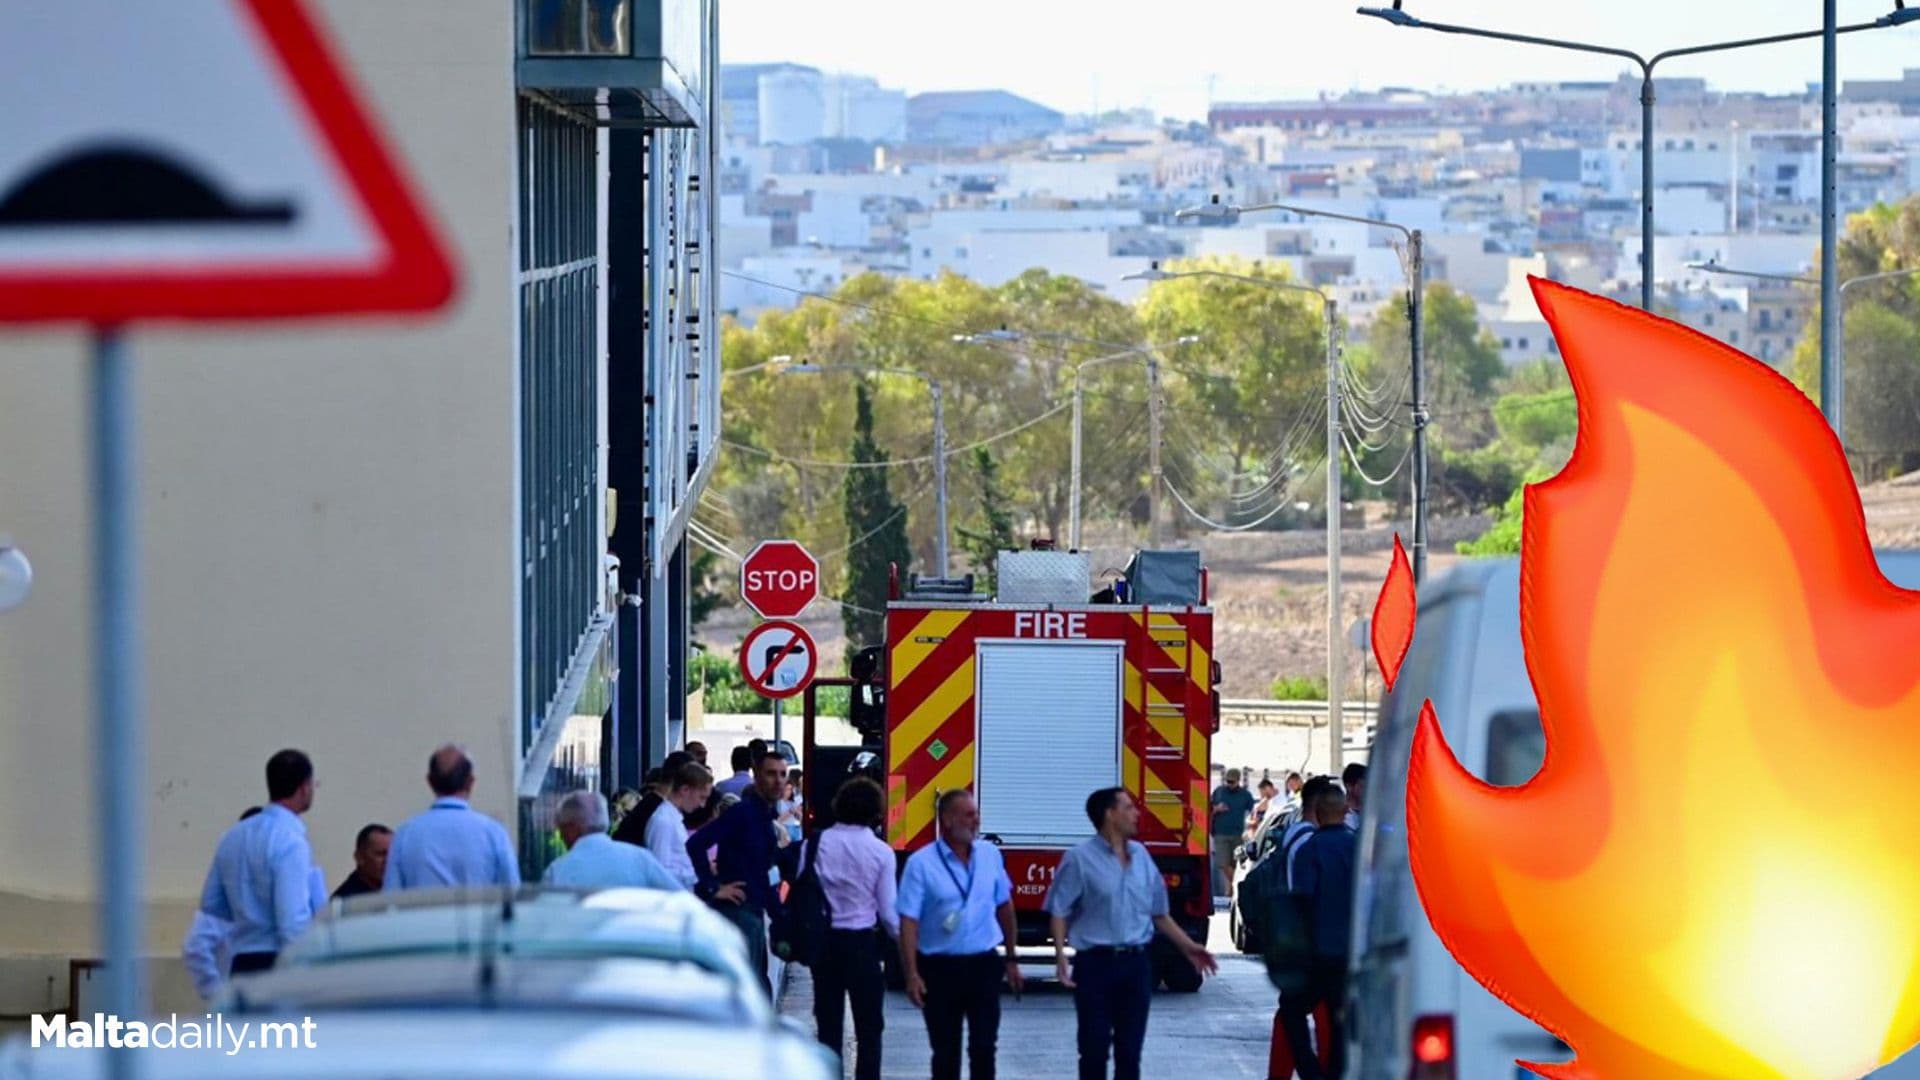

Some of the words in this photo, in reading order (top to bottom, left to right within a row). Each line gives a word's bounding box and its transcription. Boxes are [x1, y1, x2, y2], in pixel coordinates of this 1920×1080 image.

[748, 570, 814, 591] STOP
[1015, 612, 1087, 638] FIRE
[1016, 884, 1046, 895] KEEP
